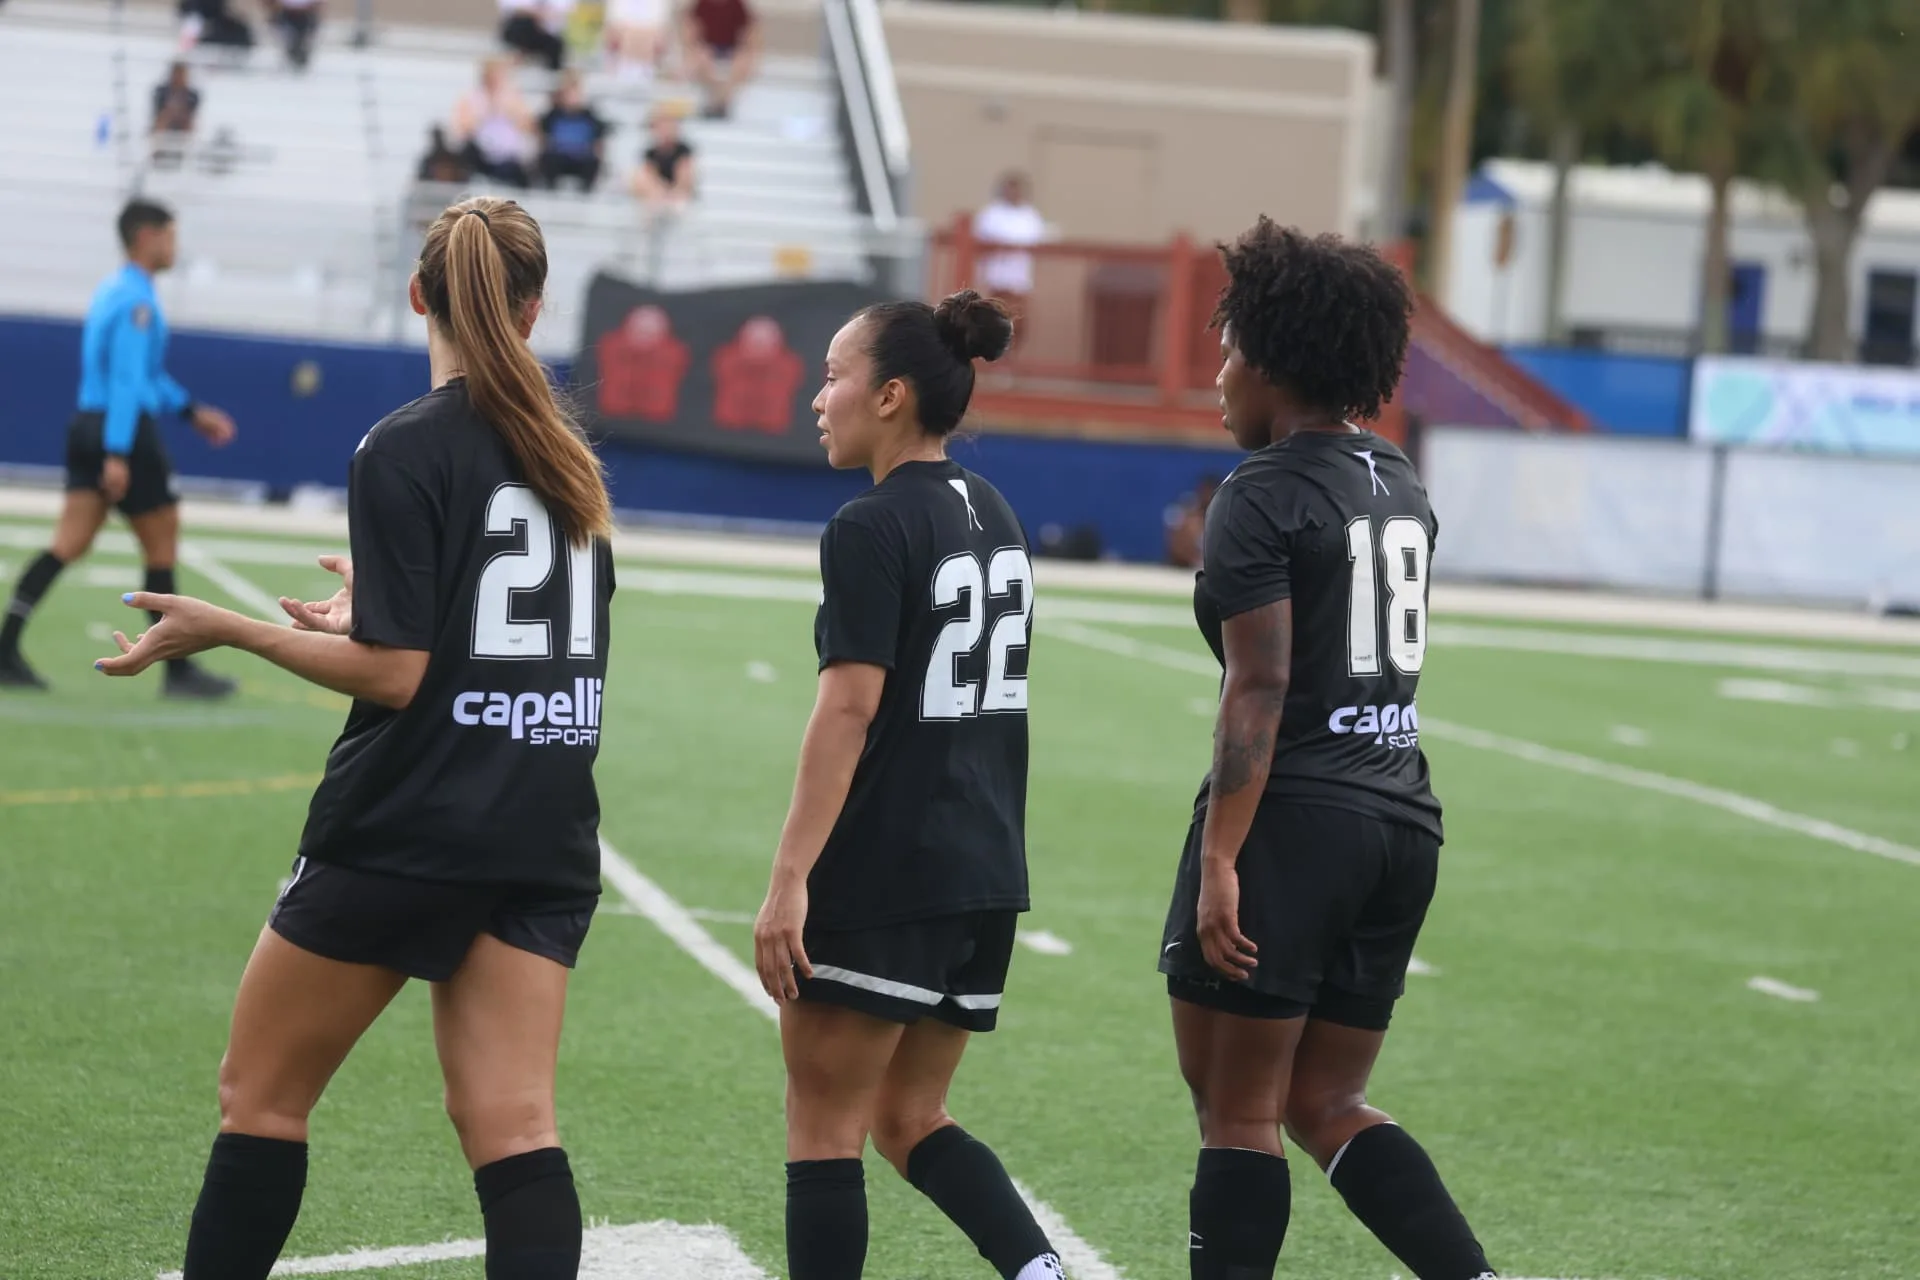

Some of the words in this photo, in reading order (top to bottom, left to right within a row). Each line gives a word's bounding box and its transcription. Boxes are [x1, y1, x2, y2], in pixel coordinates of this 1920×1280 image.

[470, 481, 597, 659] 21
[918, 545, 1034, 722] 22
[1344, 515, 1430, 677] 18
[452, 677, 602, 740] capelli
[529, 727, 599, 746] SPORT
